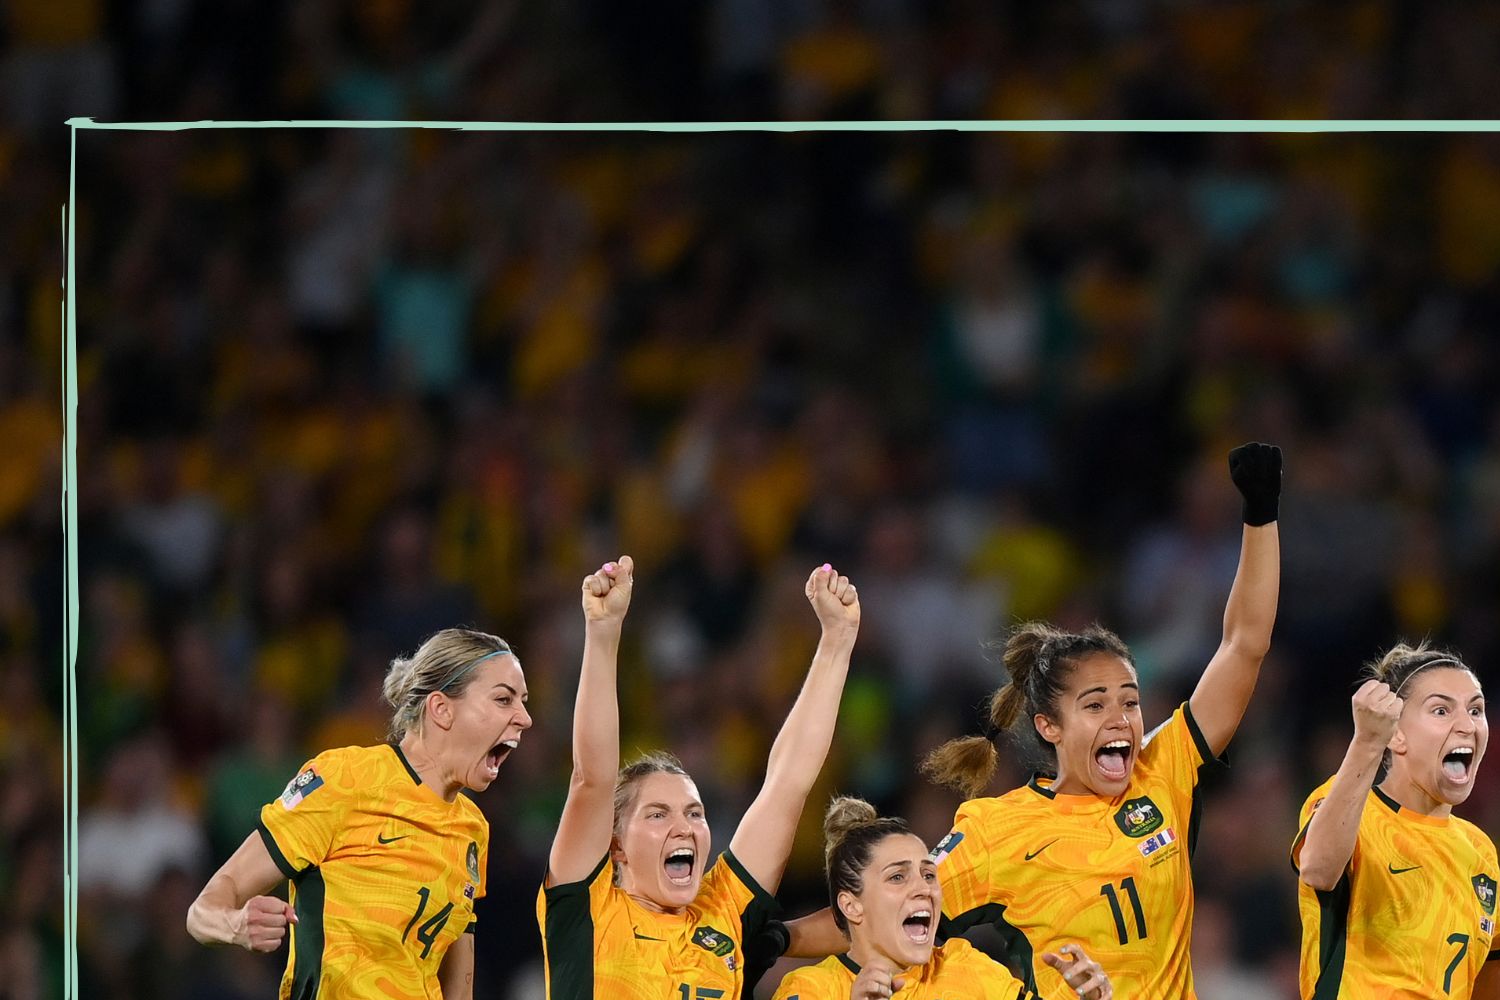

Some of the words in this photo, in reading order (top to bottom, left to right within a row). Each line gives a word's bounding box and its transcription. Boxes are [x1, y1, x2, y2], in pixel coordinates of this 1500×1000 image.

[401, 886, 455, 961] 14
[1099, 876, 1148, 946] 11
[1443, 932, 1470, 996] 7
